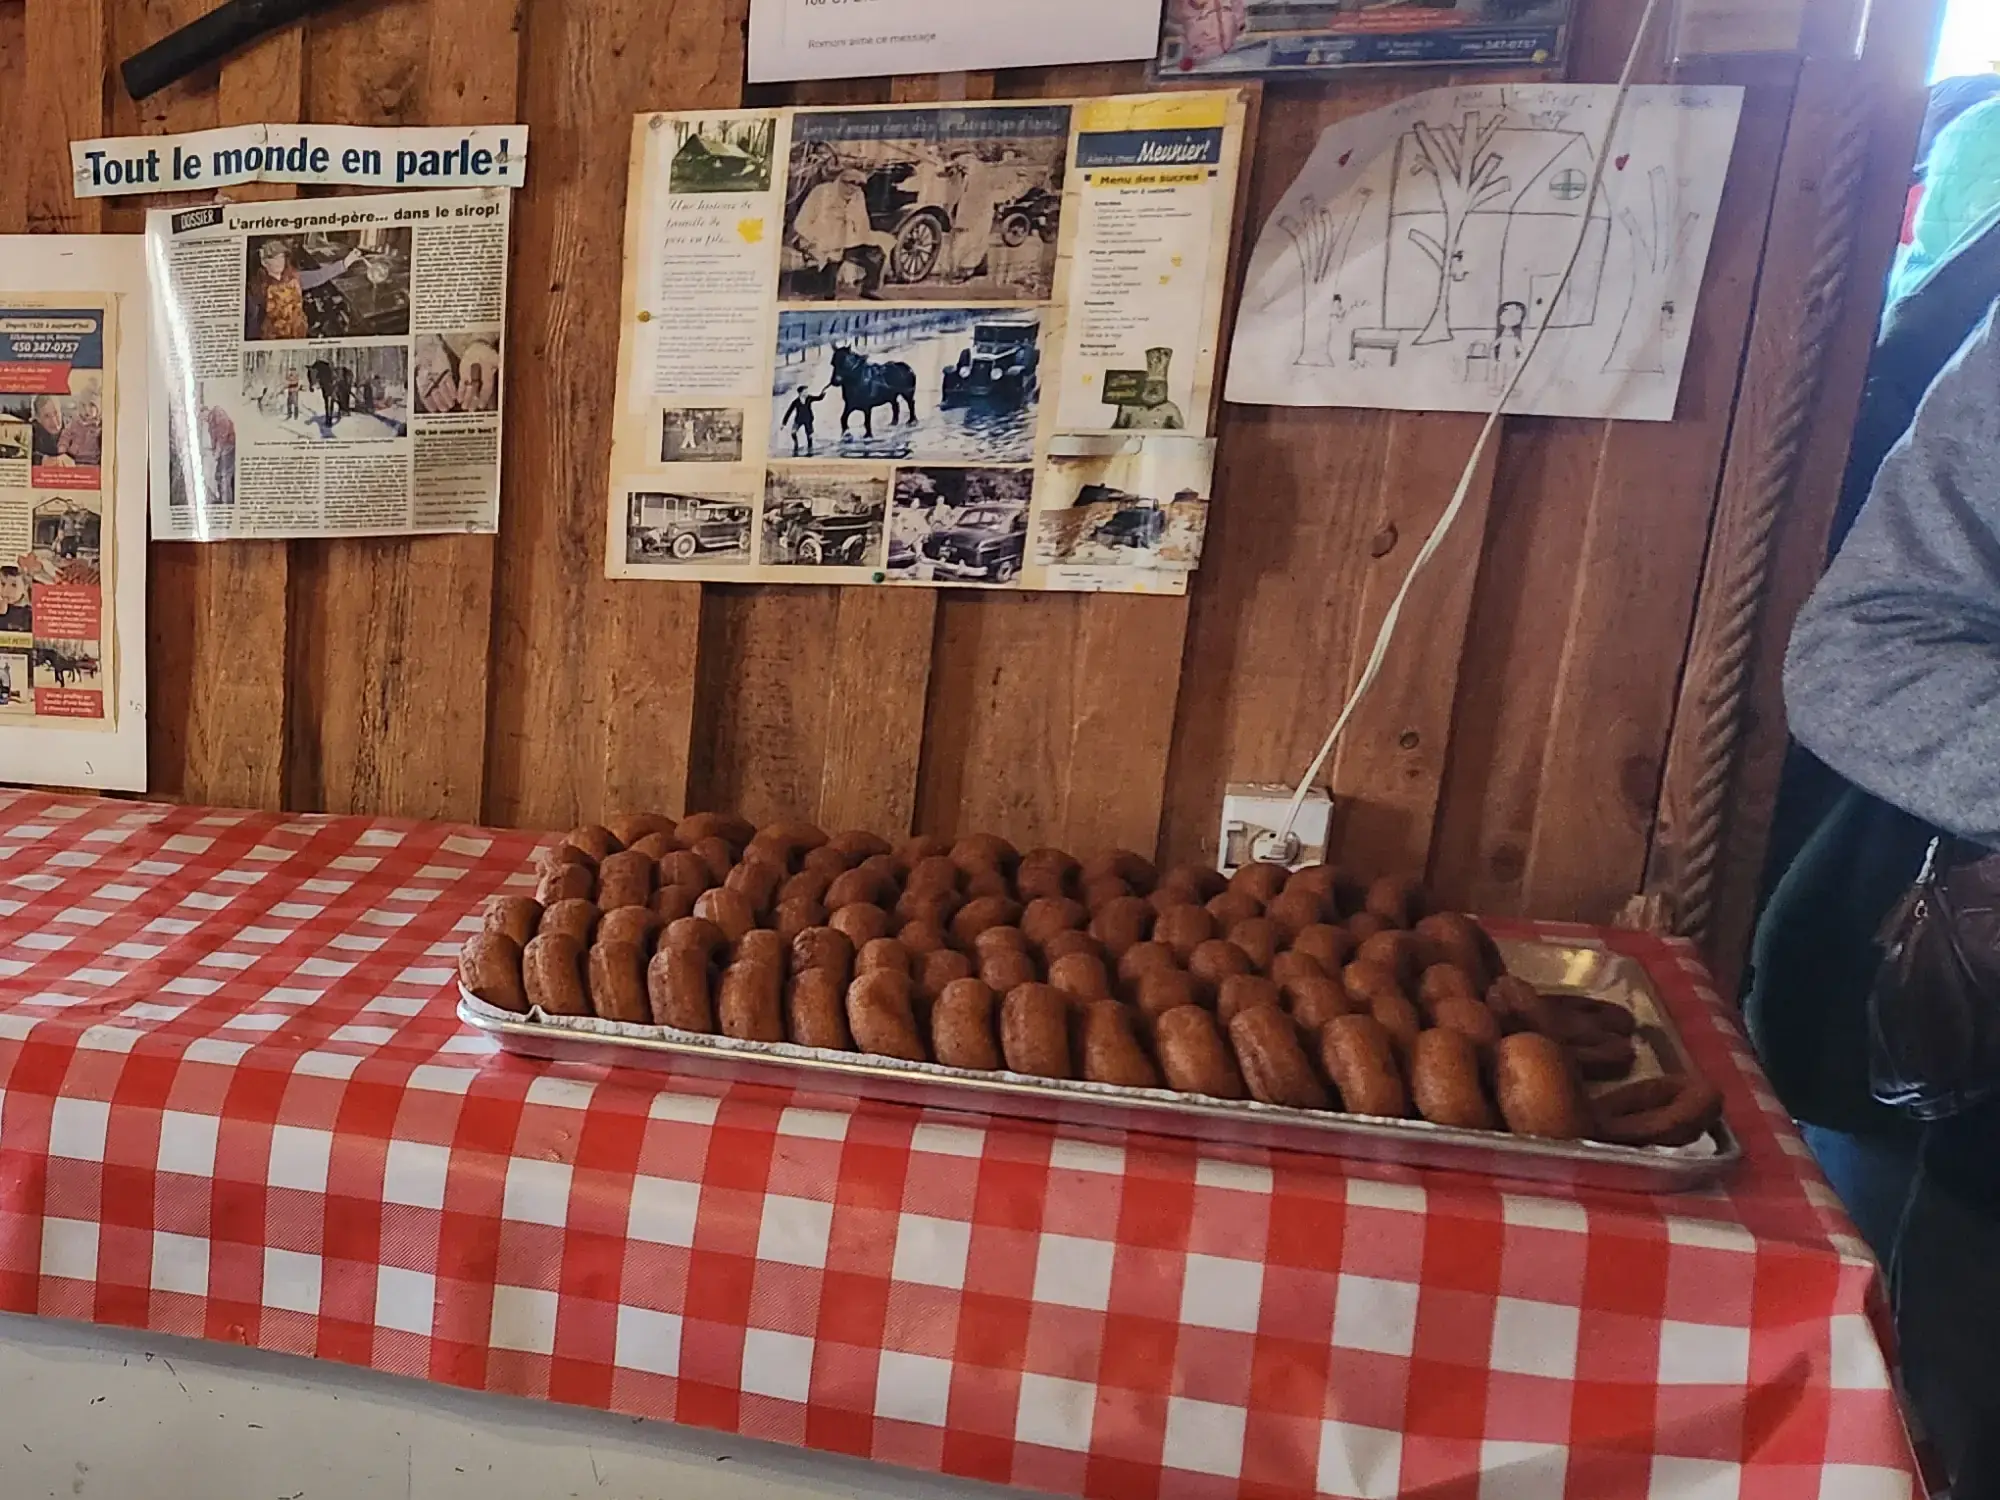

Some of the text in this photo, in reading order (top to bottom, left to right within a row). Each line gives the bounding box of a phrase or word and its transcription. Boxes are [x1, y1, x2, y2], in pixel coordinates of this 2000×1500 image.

[85, 137, 509, 185] Tout le monde en parle!
[1136, 136, 1211, 163] Meunier!
[1100, 173, 1199, 185] Menu des sucres
[180, 209, 215, 230] DOSSIER
[229, 203, 501, 231] L'arrière-grand-père... dans le sirop!
[11, 341, 80, 353] 450 347-0757
